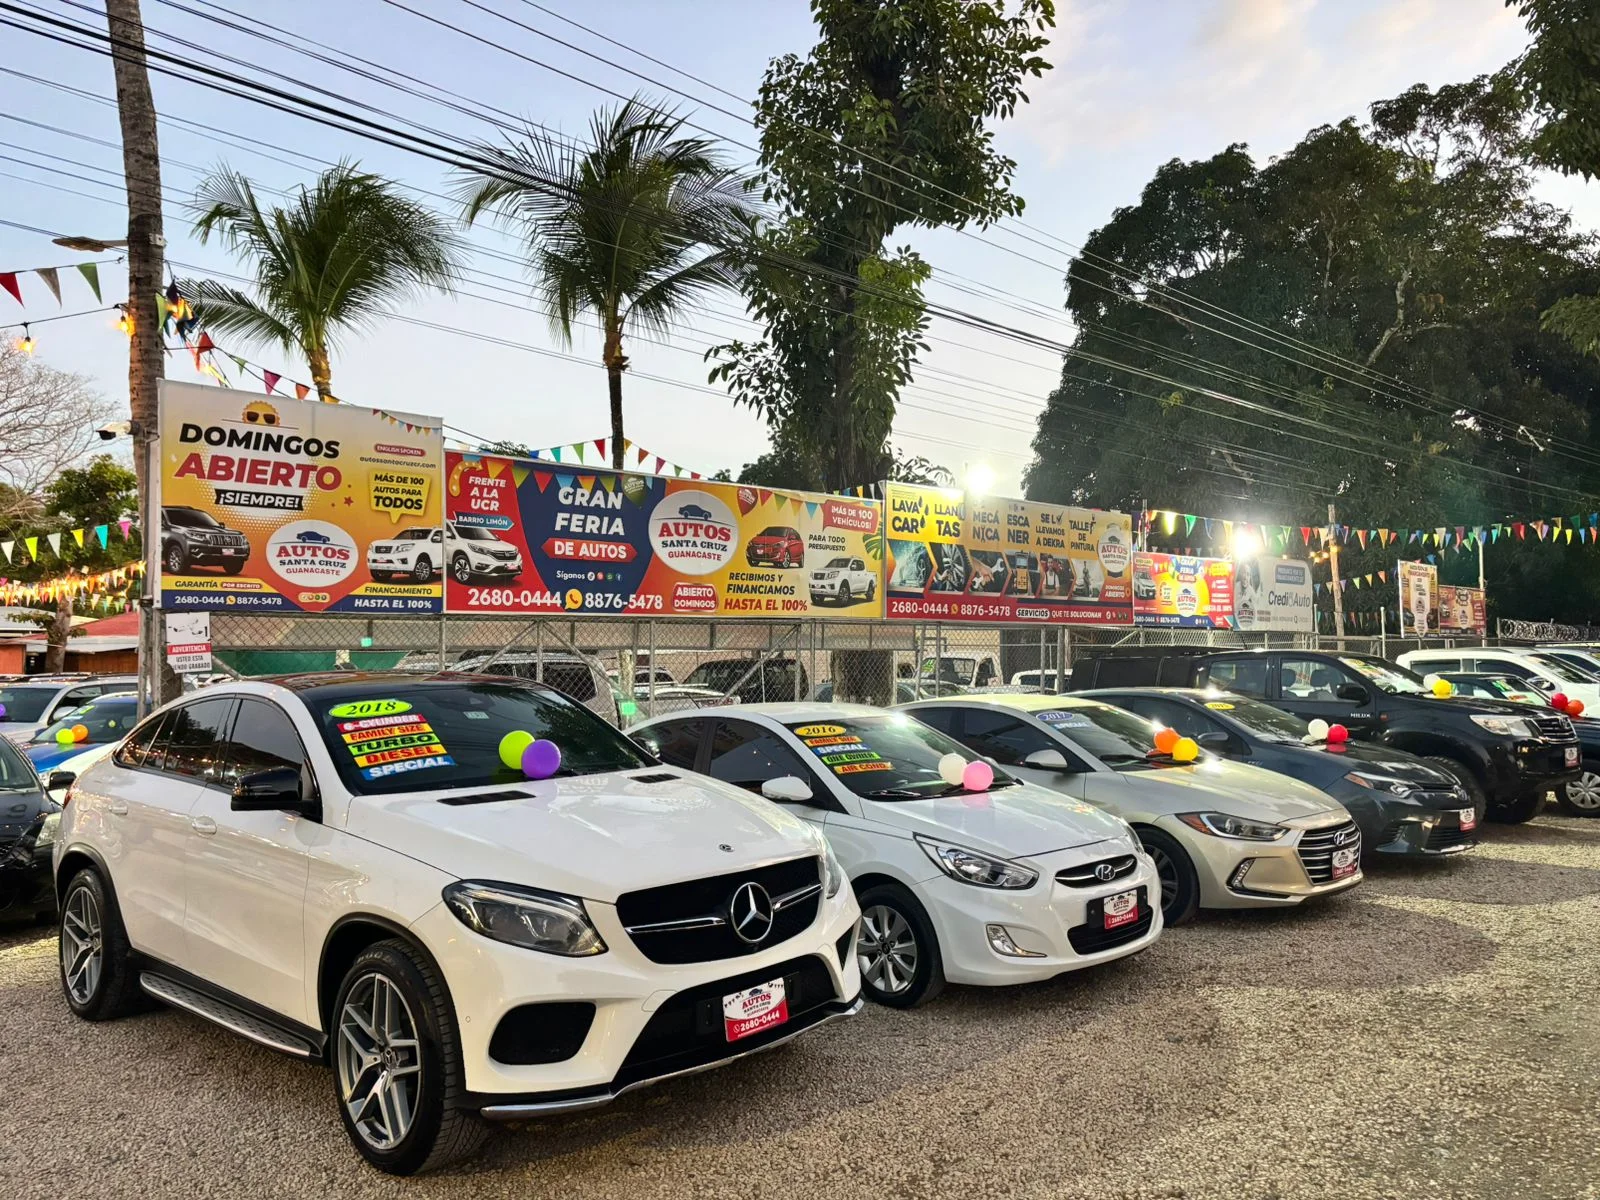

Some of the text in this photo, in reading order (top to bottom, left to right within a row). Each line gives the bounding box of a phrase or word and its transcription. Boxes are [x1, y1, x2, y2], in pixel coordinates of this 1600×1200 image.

[179, 423, 340, 459] DOMINGOS
[360, 456, 436, 468] autossantacruzcr.com
[174, 453, 342, 491] ABIERTO
[374, 473, 394, 482] MÁS
[396, 476, 408, 484] DE
[469, 476, 507, 488] FRENTE
[373, 486, 422, 496] AUTOS PARA
[470, 487, 498, 499] A LA
[219, 491, 299, 508] ¡SIEMPRE!
[374, 496, 423, 510] TODOS
[558, 487, 622, 510] GRAN
[471, 499, 499, 511] UCR
[892, 499, 920, 514] LAVA
[934, 504, 958, 516] LLAN
[832, 505, 846, 515] ¡MÁS
[859, 510, 872, 519] 100
[972, 510, 999, 524] MECÁ
[1041, 513, 1050, 523] SE
[459, 516, 508, 526] BARRIO LIMÓN
[554, 512, 625, 536] FERIA
[833, 516, 871, 529] VEHÍCULOS!
[892, 516, 919, 533] CAR
[1007, 514, 1030, 528] ESCA
[658, 523, 731, 542] AUTOS
[936, 520, 960, 537] TAS
[1036, 526, 1065, 536] LLEVAMOS
[1007, 530, 1030, 545] NER
[1036, 536, 1065, 548] A DEKRA
[1078, 533, 1086, 541] DE
[554, 541, 626, 559] DE AUTOS
[661, 540, 727, 552] SANTA CRUZ
[808, 543, 845, 551] PRESUPUESTO
[1070, 542, 1095, 552] PINTURA
[1101, 545, 1128, 555] AUTOS
[276, 545, 350, 561] AUTOS
[668, 550, 721, 561] GUANACASTE
[320, 560, 347, 568] CRUZ
[286, 568, 340, 576] GUANACASTE
[556, 570, 585, 580] Síganos
[729, 573, 775, 582] RECIBIMOS
[175, 580, 218, 588] GARANTÍA
[726, 585, 795, 595] FINANCIAMOS
[364, 587, 432, 595] FINANCIAMIENTO
[676, 587, 713, 597] ABIERTO
[175, 596, 282, 605] 2680-0444 8876-5478
[354, 599, 432, 608] HASTA EL 100%
[468, 589, 663, 609] 2680-0444 8876-5478
[674, 599, 715, 608] DOMINGOS
[1293, 593, 1310, 608] Auto
[724, 600, 807, 611] HASTA EL 100%
[892, 601, 1011, 616] 2680-0444 8876-5478
[1017, 609, 1049, 617] SERVICIOS
[1052, 610, 1062, 618] QUE
[172, 645, 206, 653] ADVERTENCIA
[346, 701, 396, 715] 2018
[1044, 712, 1069, 721] 2017
[350, 724, 424, 741] FAMILY SIZE
[805, 726, 836, 735] 2016
[352, 734, 433, 752] TURBO
[818, 744, 868, 754] SPECIAL
[365, 746, 440, 764] DIESEL
[826, 754, 845, 762] ONE
[369, 757, 451, 778] SPECIAL
[841, 762, 886, 773] AIR COND
[1113, 899, 1129, 908] AUTOS
[742, 993, 771, 1009] AUTOS
[740, 1010, 780, 1032] 2680-0444
